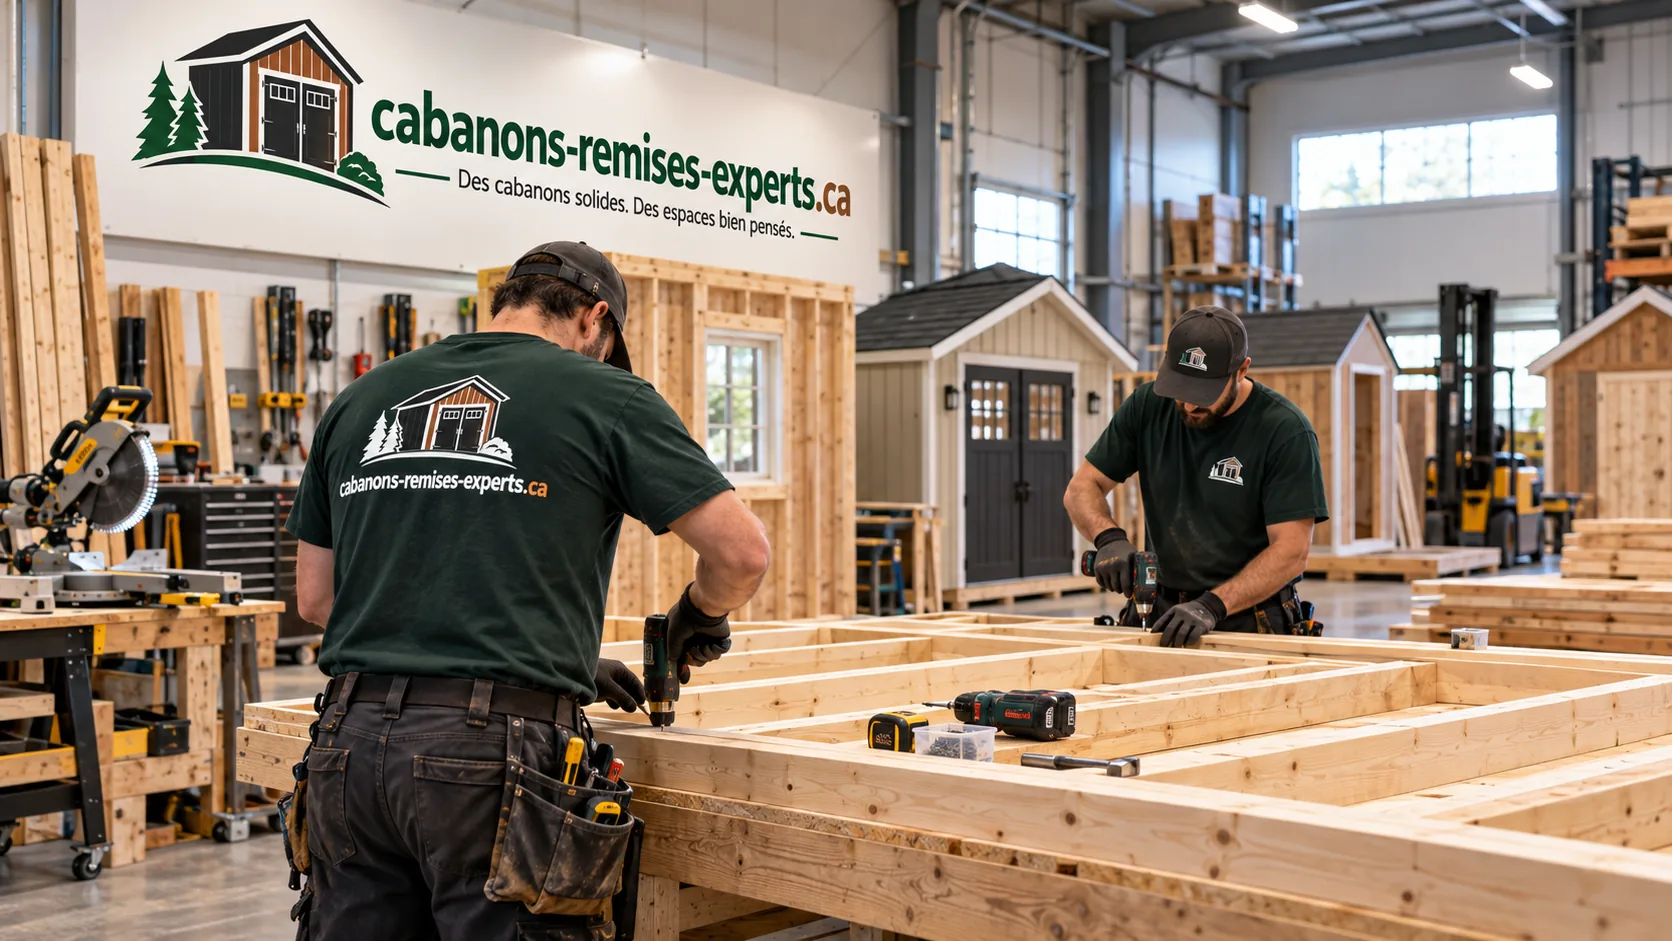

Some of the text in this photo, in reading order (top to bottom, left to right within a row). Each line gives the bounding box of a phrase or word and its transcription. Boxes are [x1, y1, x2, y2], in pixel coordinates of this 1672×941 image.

[371, 89, 852, 217] cabanons-remises-experts.ca
[458, 168, 796, 240] Des cabanons solides. Des espaces bien pensés.
[339, 470, 548, 498] cabanons-remises-experts.ca
